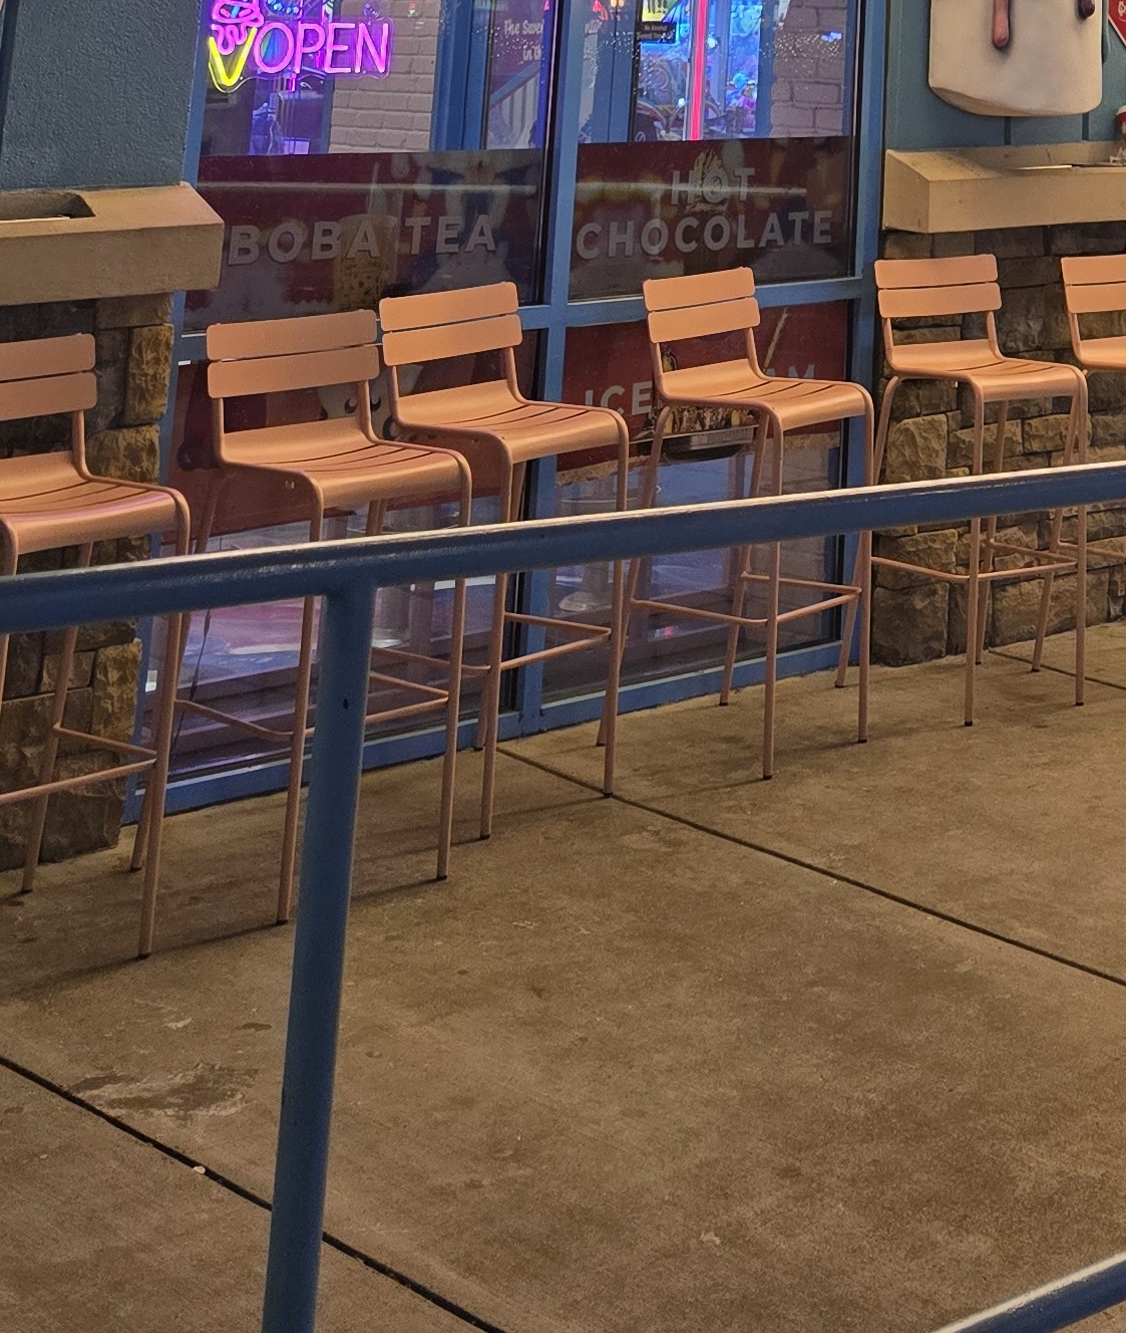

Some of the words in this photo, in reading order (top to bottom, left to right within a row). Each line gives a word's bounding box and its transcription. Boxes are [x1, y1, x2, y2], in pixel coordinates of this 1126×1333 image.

[253, 20, 389, 74] OPEN
[671, 167, 757, 206] HOT
[228, 221, 381, 266] BOBA
[405, 213, 498, 256] TEA
[575, 209, 834, 261] CHOCOLATE
